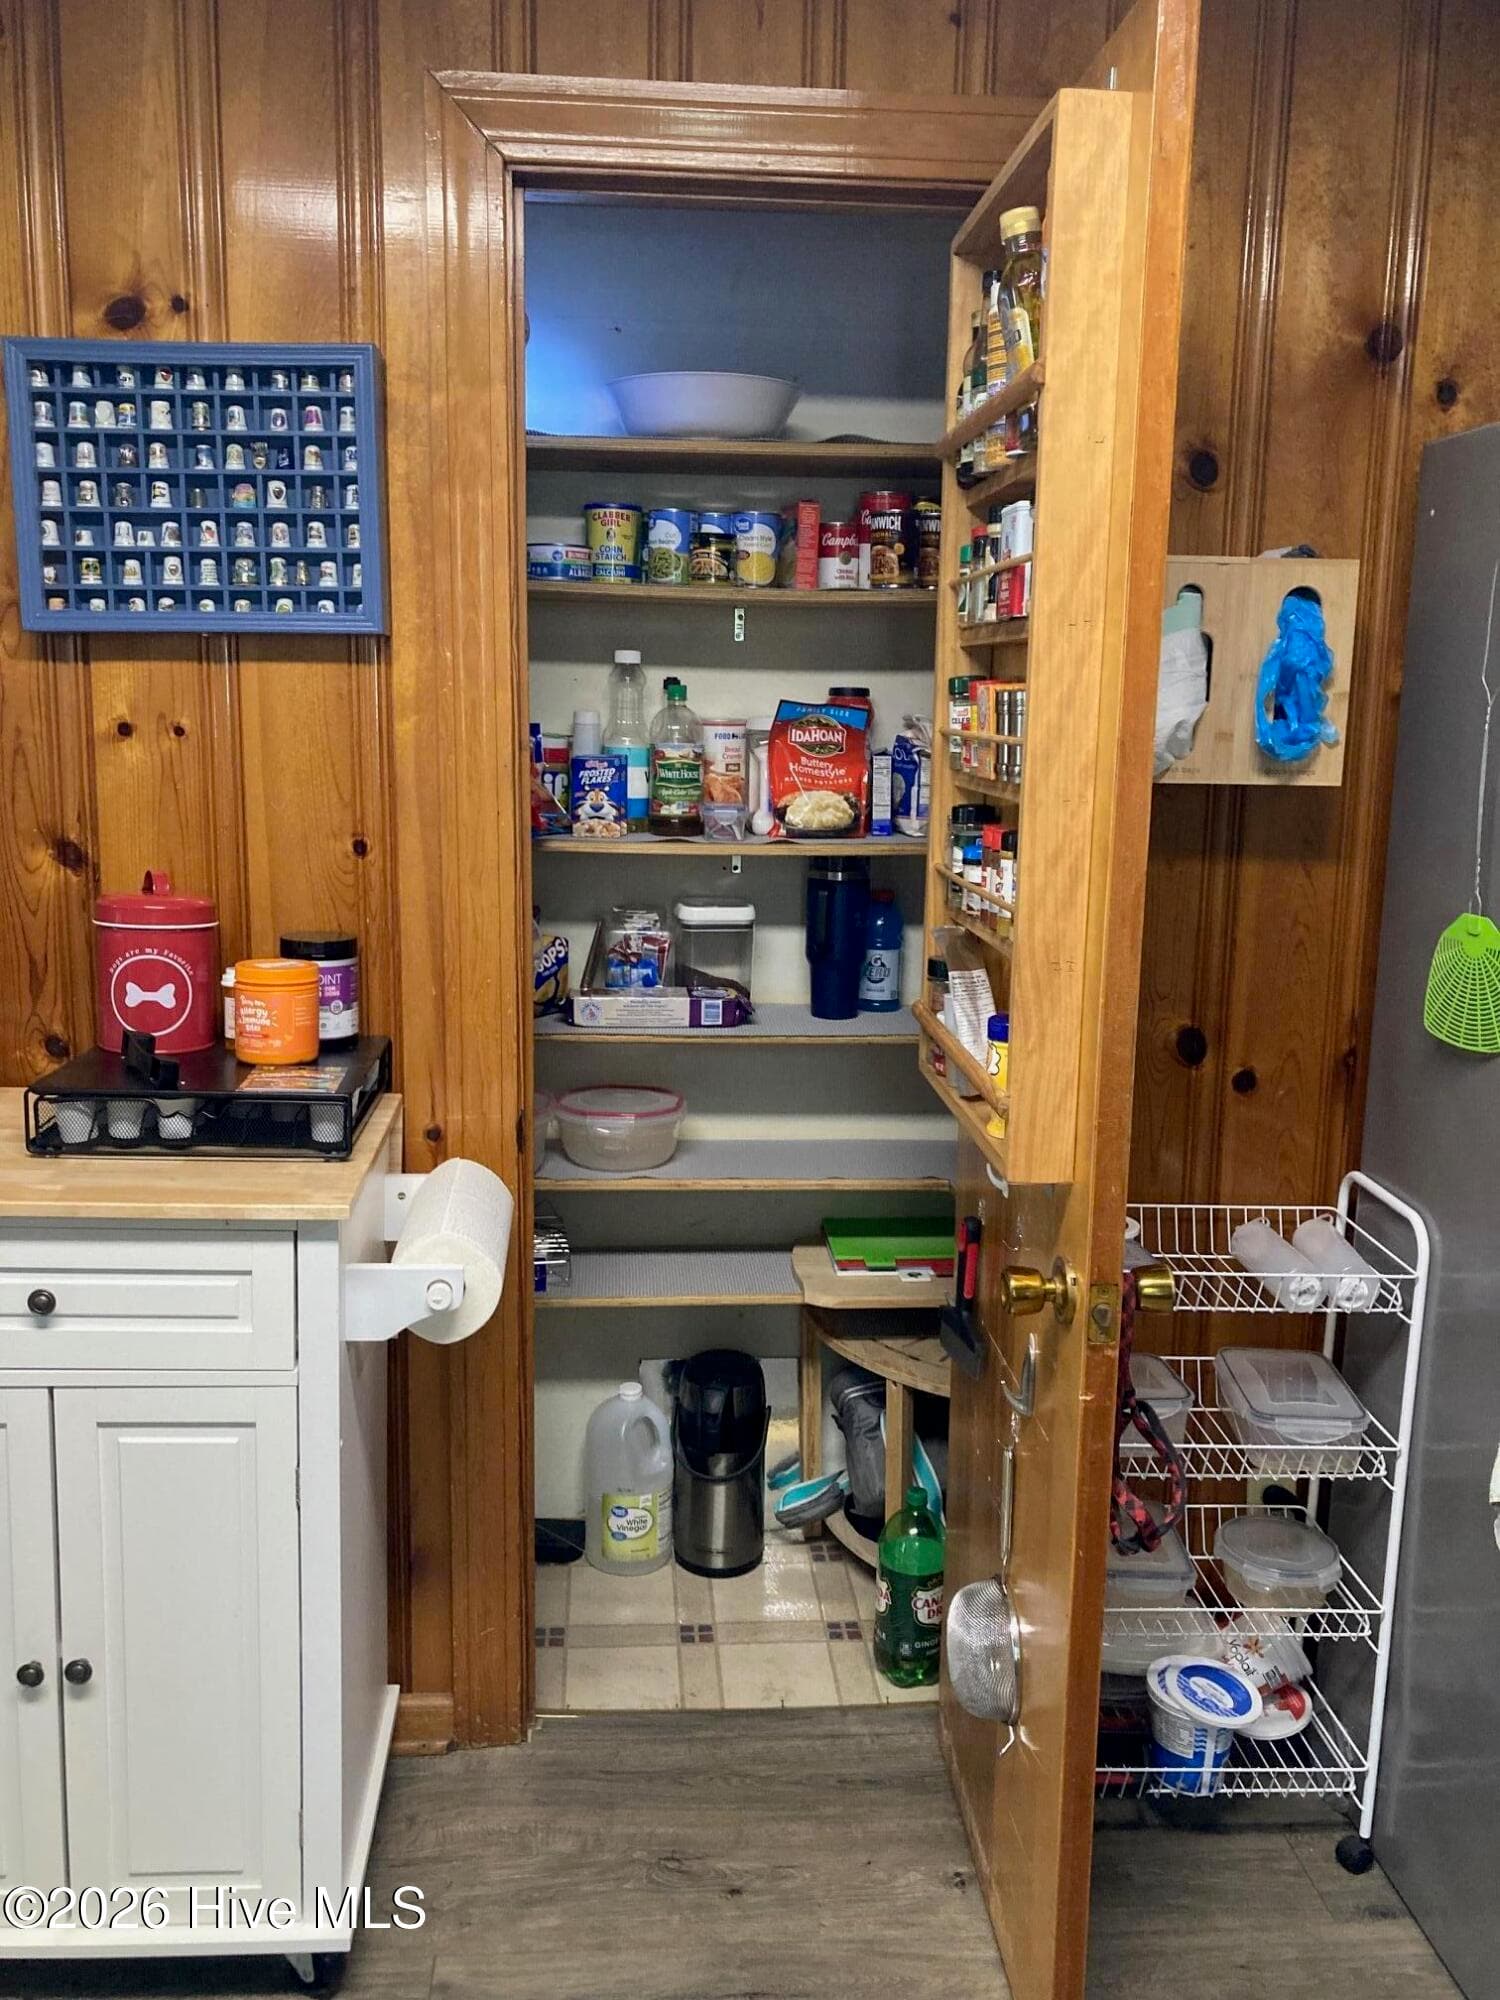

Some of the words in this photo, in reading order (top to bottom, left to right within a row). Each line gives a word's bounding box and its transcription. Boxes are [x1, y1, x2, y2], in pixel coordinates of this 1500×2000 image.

[592, 511, 631, 521] CLABBER
[600, 518, 622, 527] GIRL
[599, 544, 623, 553] CORN
[595, 552, 627, 561] STARCH
[795, 706, 826, 714] FAMILY
[829, 709, 850, 718] SIZE
[714, 732, 731, 740] FOOD
[791, 728, 843, 743] IDAHOAN
[800, 756, 834, 770] Buttery
[579, 767, 616, 779] FROSTED
[788, 762, 847, 779] Homestyle
[543, 773, 569, 800] if
[580, 776, 612, 785] FLAKES
[814, 777, 853, 785] POTATOES
[536, 937, 569, 973] OOPS!
[319, 973, 342, 985] OINT
[616, 1524, 648, 1533] Vinegar
[913, 1597, 940, 1611] CAN
[927, 1605, 943, 1619] DR
